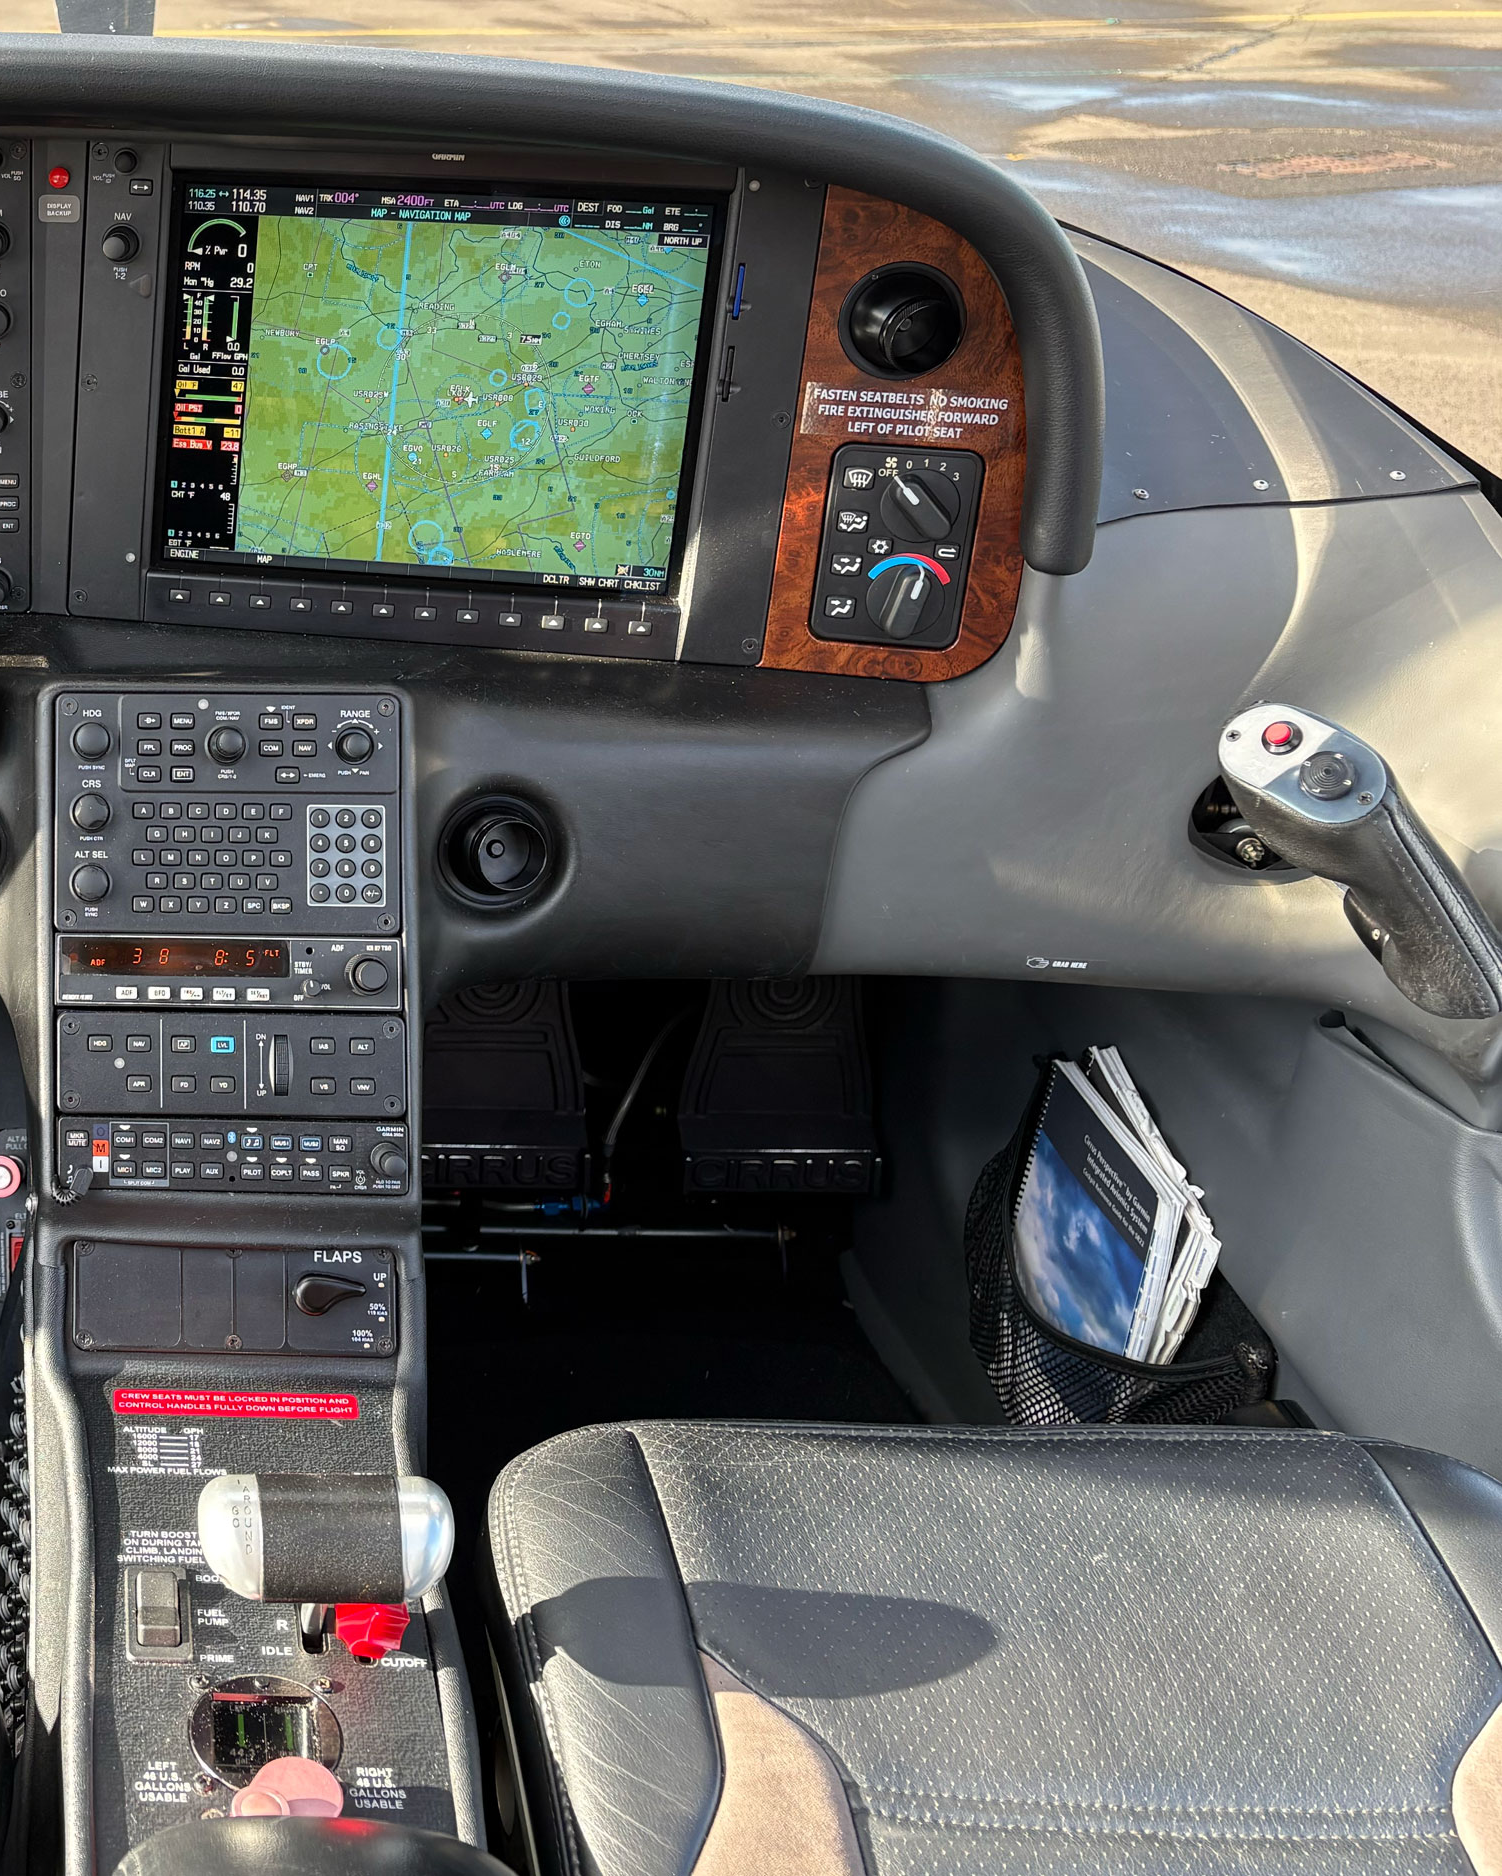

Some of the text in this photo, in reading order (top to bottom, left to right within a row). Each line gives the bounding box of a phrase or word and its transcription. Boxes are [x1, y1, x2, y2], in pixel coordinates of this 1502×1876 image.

[188, 188, 216, 198] 116.25
[232, 189, 266, 200] 114.35
[296, 194, 314, 202] NAV1
[188, 201, 314, 214] 110.35 110.70 NAV2
[577, 202, 599, 212] DEST
[371, 208, 471, 221] MAP NAVIGATION MAP
[664, 236, 702, 245] NORTH UP
[814, 389, 1008, 409] FASTEN SEATBELTS NO SMOKING
[818, 405, 999, 425] FIRE EXTINGUISHER FORWARD
[848, 421, 963, 438] LEFT OF PILOT SEAT
[878, 469, 898, 477] OFF
[171, 551, 199, 559] ENGINE
[543, 575, 569, 584] DCLTR
[624, 581, 660, 590] CHKLIST
[340, 710, 370, 718] RANGE
[82, 780, 101, 788] CRS
[314, 1251, 362, 1263] FLAPS
[373, 1273, 387, 1281] UP
[194, 1468, 227, 1476] FLOWS
[130, 1530, 158, 1538] TURN
[262, 1646, 293, 1655] IDLE
[381, 1658, 427, 1667] CUTOFF
[148, 1762, 177, 1771] LEFT
[356, 1767, 393, 1777] RIGHT
[135, 1782, 191, 1791] GALLONS
[350, 1789, 406, 1799] GALLONS
